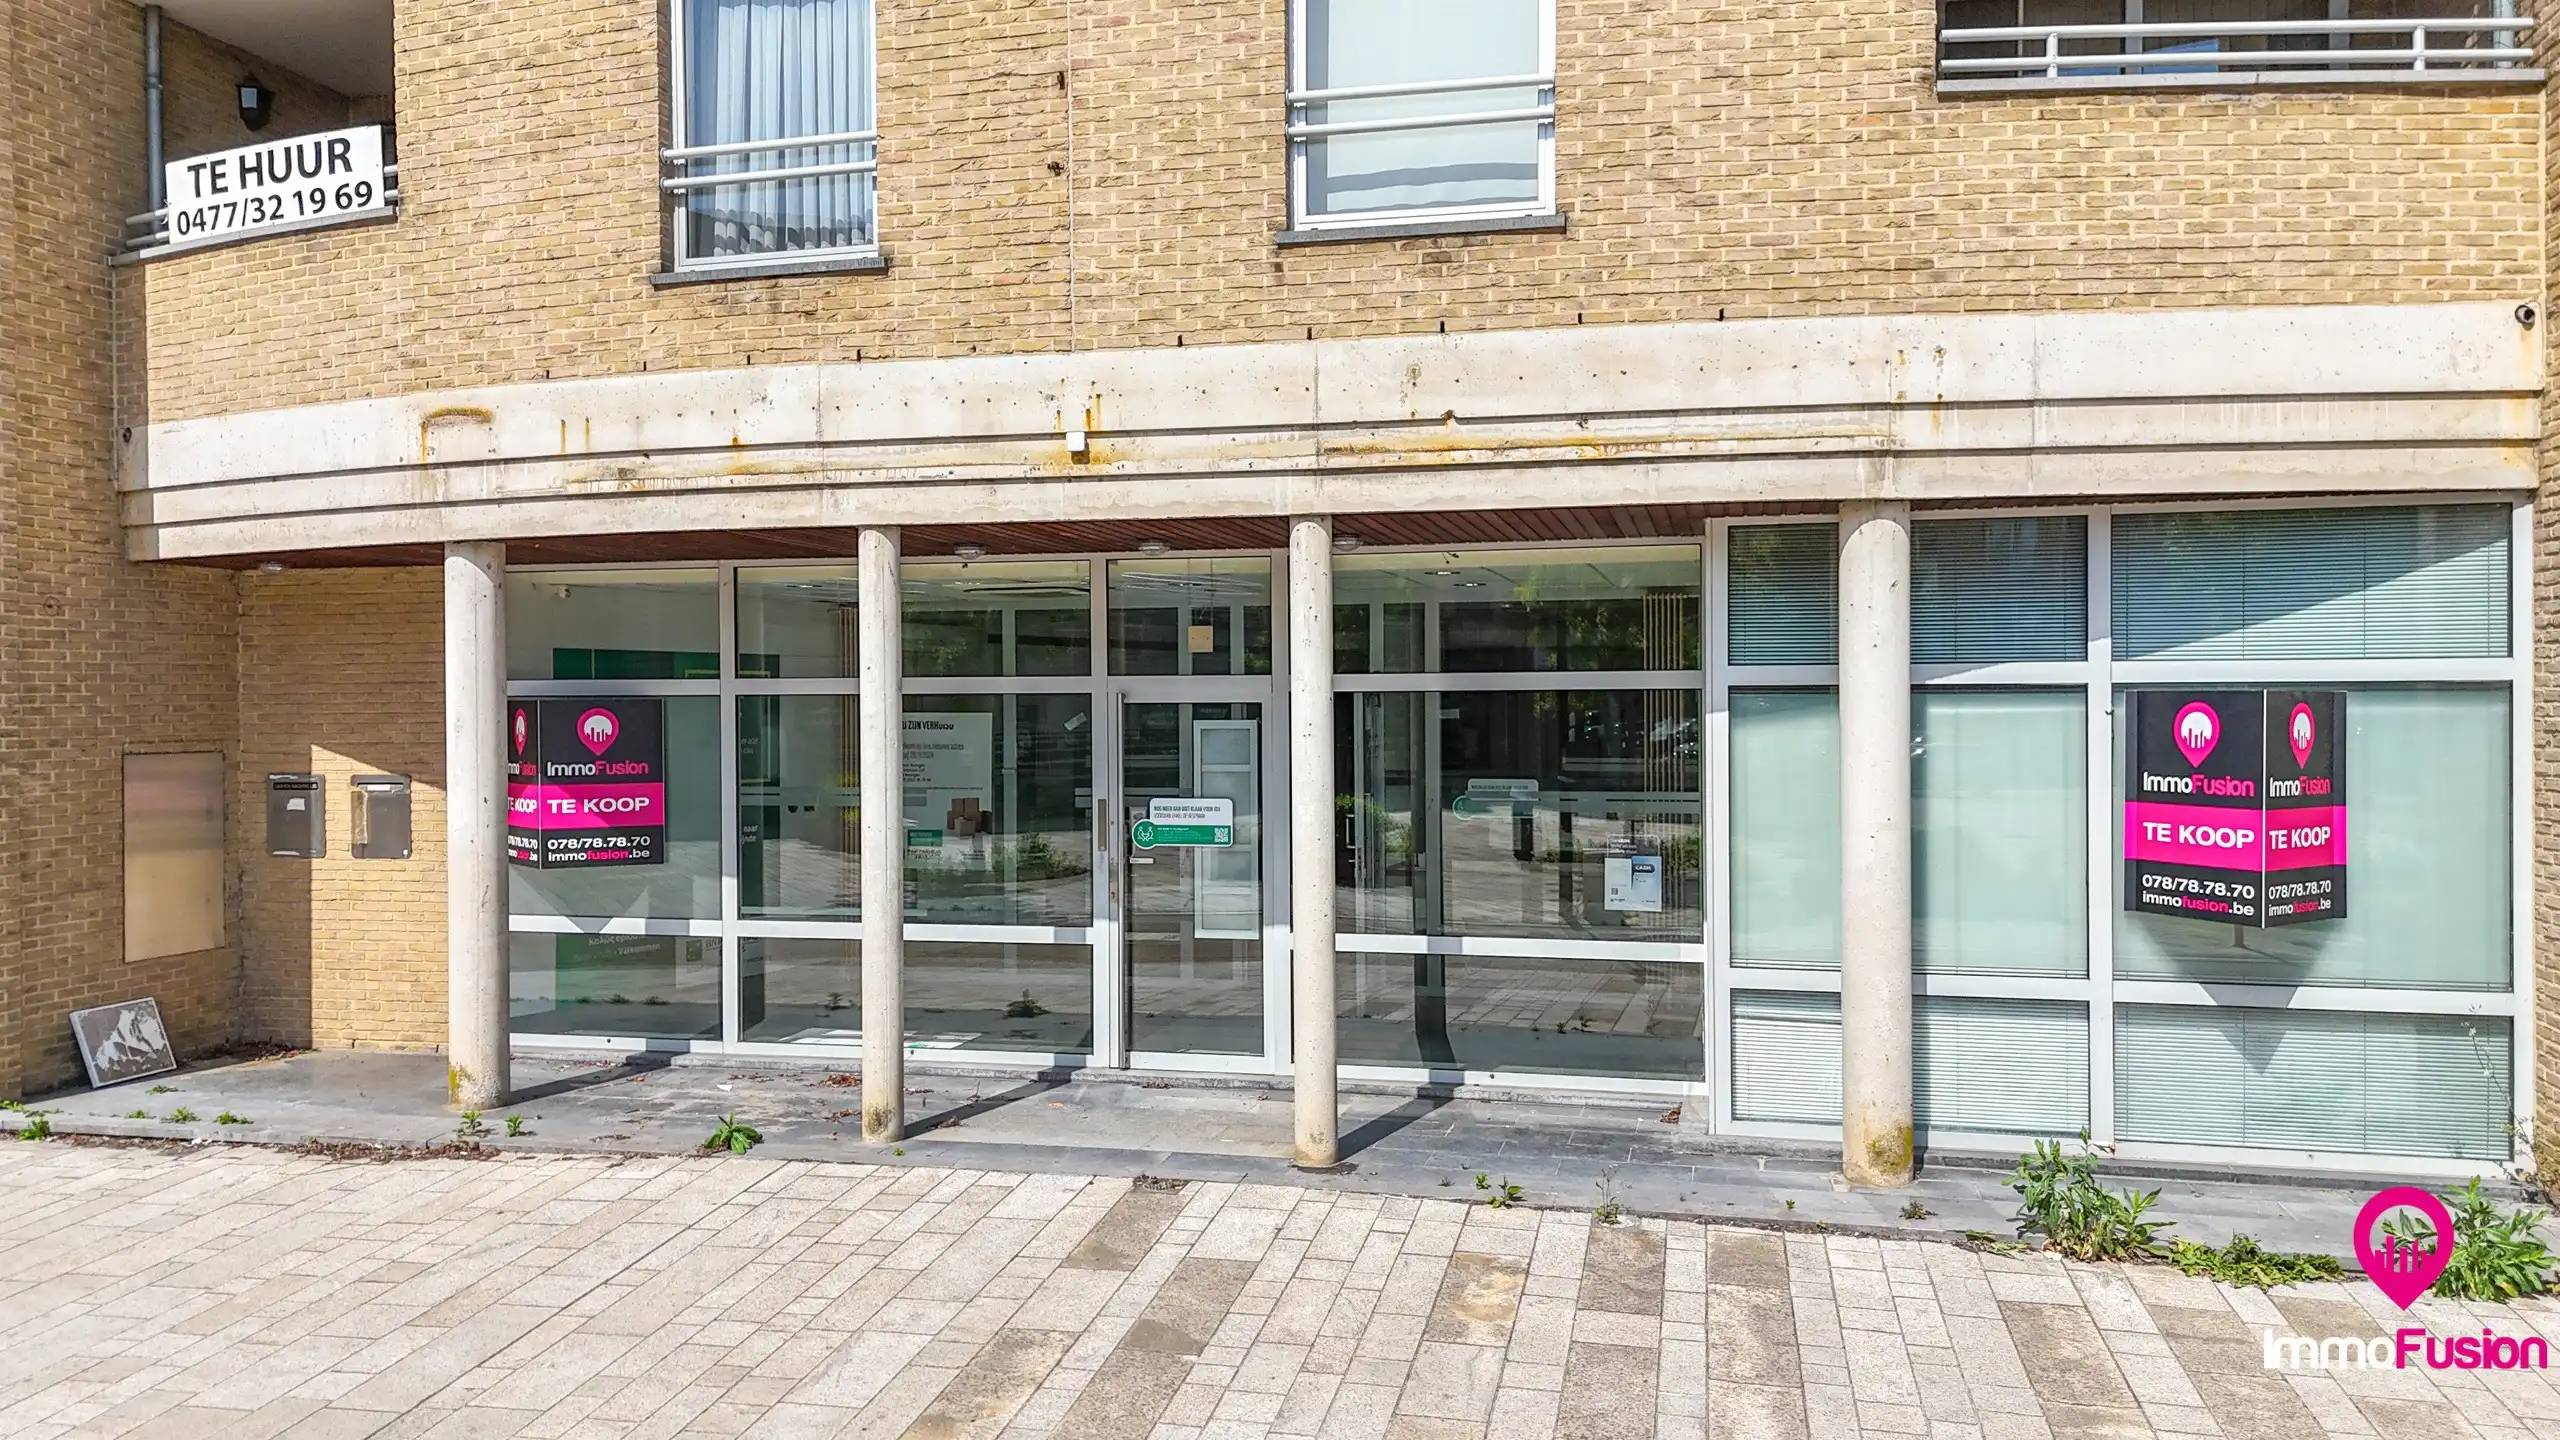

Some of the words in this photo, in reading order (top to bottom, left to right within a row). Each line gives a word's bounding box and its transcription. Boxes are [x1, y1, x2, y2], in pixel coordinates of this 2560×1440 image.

[186, 159, 229, 198] TE
[239, 137, 354, 190] HUUR
[177, 193, 285, 235] 0477/32
[292, 187, 327, 216] 19
[334, 181, 374, 210] 69
[547, 760, 649, 777] ImmoFusion
[2143, 772, 2256, 797] ImmoFusion
[2269, 776, 2330, 798] ImmoFusion
[514, 798, 538, 814] KOOP
[547, 798, 577, 814] TE
[583, 797, 650, 813] KOOP
[547, 836, 651, 850] 078/78.78.70
[2143, 822, 2172, 843] TE
[2179, 825, 2255, 849] KOOP
[2269, 830, 2288, 850] TE
[2291, 826, 2331, 848] KOOP
[547, 849, 651, 862] immofusion.be
[2142, 874, 2255, 899] 078/78.78.70
[2268, 880, 2332, 900] 078/78.78.70
[2142, 891, 2255, 916] immofusion.be
[2268, 899, 2332, 917] immofusion.be
